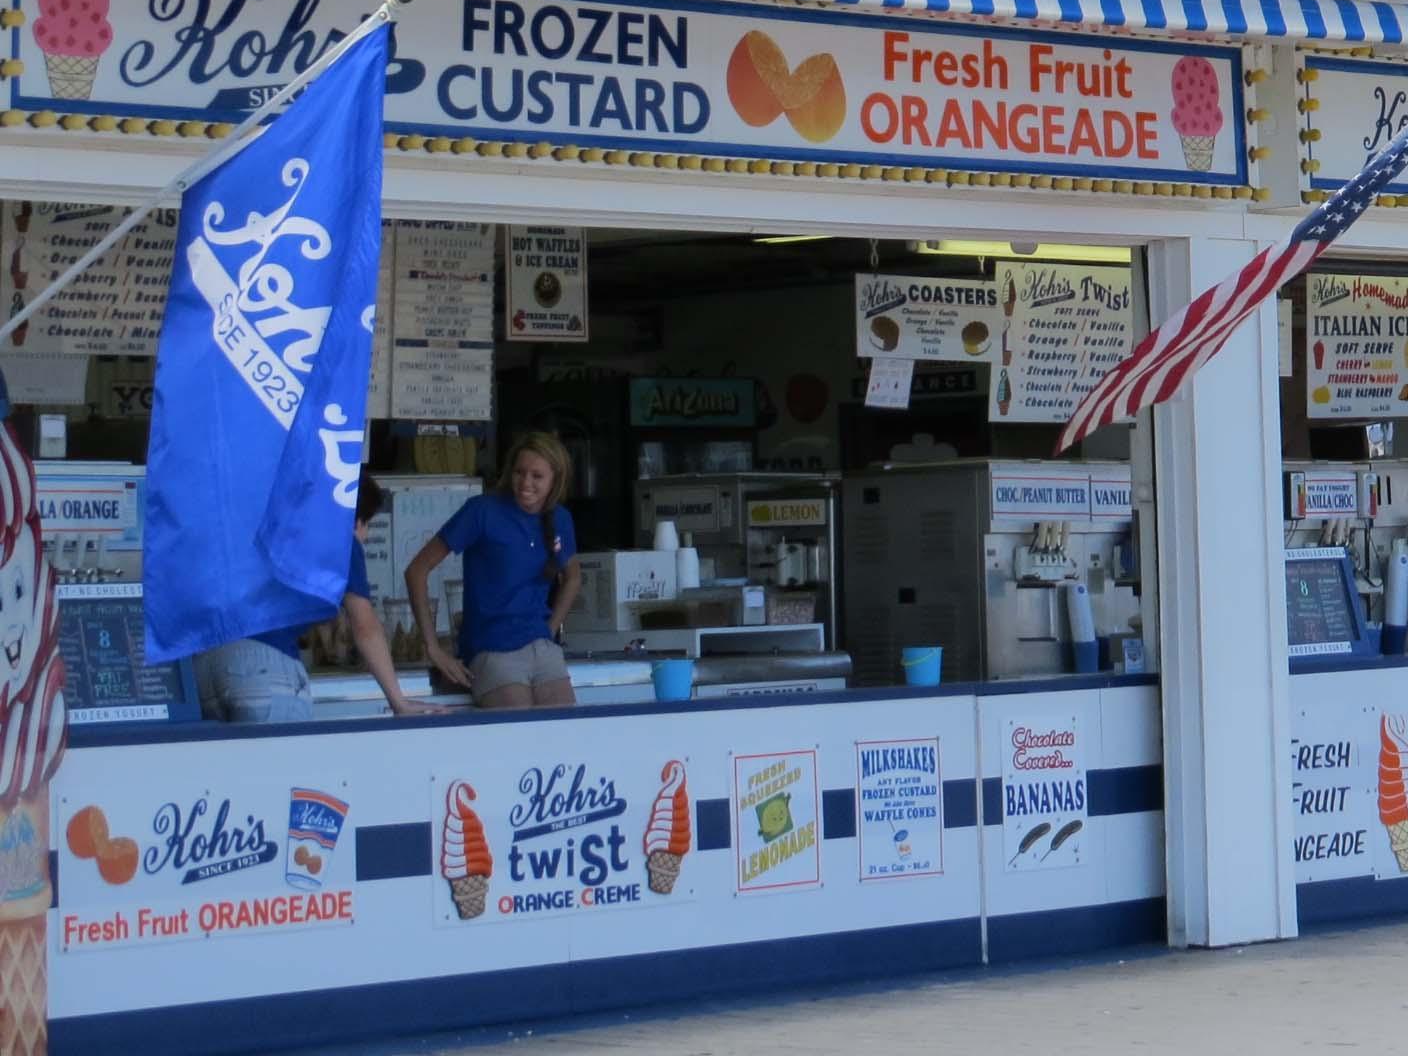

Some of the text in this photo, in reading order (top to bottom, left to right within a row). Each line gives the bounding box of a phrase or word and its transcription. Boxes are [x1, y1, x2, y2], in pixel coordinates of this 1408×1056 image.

[883, 32, 1132, 98] Fresh Fruit
[437, 64, 710, 134] CUSTARD
[860, 92, 1160, 160] ORANGEADE
[512, 238, 580, 253] HOT WAFFLES
[526, 255, 578, 269] ICE CREAM
[908, 284, 997, 306] COASTERS
[1080, 276, 1130, 311] Twist
[1029, 319, 1126, 332] Chocolate Vanilla
[1314, 315, 1381, 337] ITALIAN
[1027, 335, 1125, 348] Orange Vanilla
[1335, 342, 1394, 354] SOFT SERVE
[1027, 350, 1077, 363] Raspberry
[242, 348, 302, 415] 1923
[1026, 366, 1078, 378] Strawberry
[1026, 381, 1063, 393] Chocolate
[1025, 397, 1073, 408] Chocolate
[1056, 488, 1086, 504] BUTTER
[773, 504, 820, 522] LEMON
[1012, 727, 1075, 748] Chocolate
[860, 745, 936, 779] MILKSHAKES
[510, 763, 617, 827] Kohr's
[862, 784, 938, 801] FROZEN CUSTARD
[1005, 779, 1085, 817] BANANAS
[864, 805, 937, 823] WAFFLE CONES
[144, 798, 267, 875] Kohr's
[741, 820, 816, 884] LEMONADE
[199, 864, 235, 878] SINCE
[498, 883, 641, 914] ORANGE CREME
[64, 891, 353, 944] Fresh Fruit ORANGEADE
